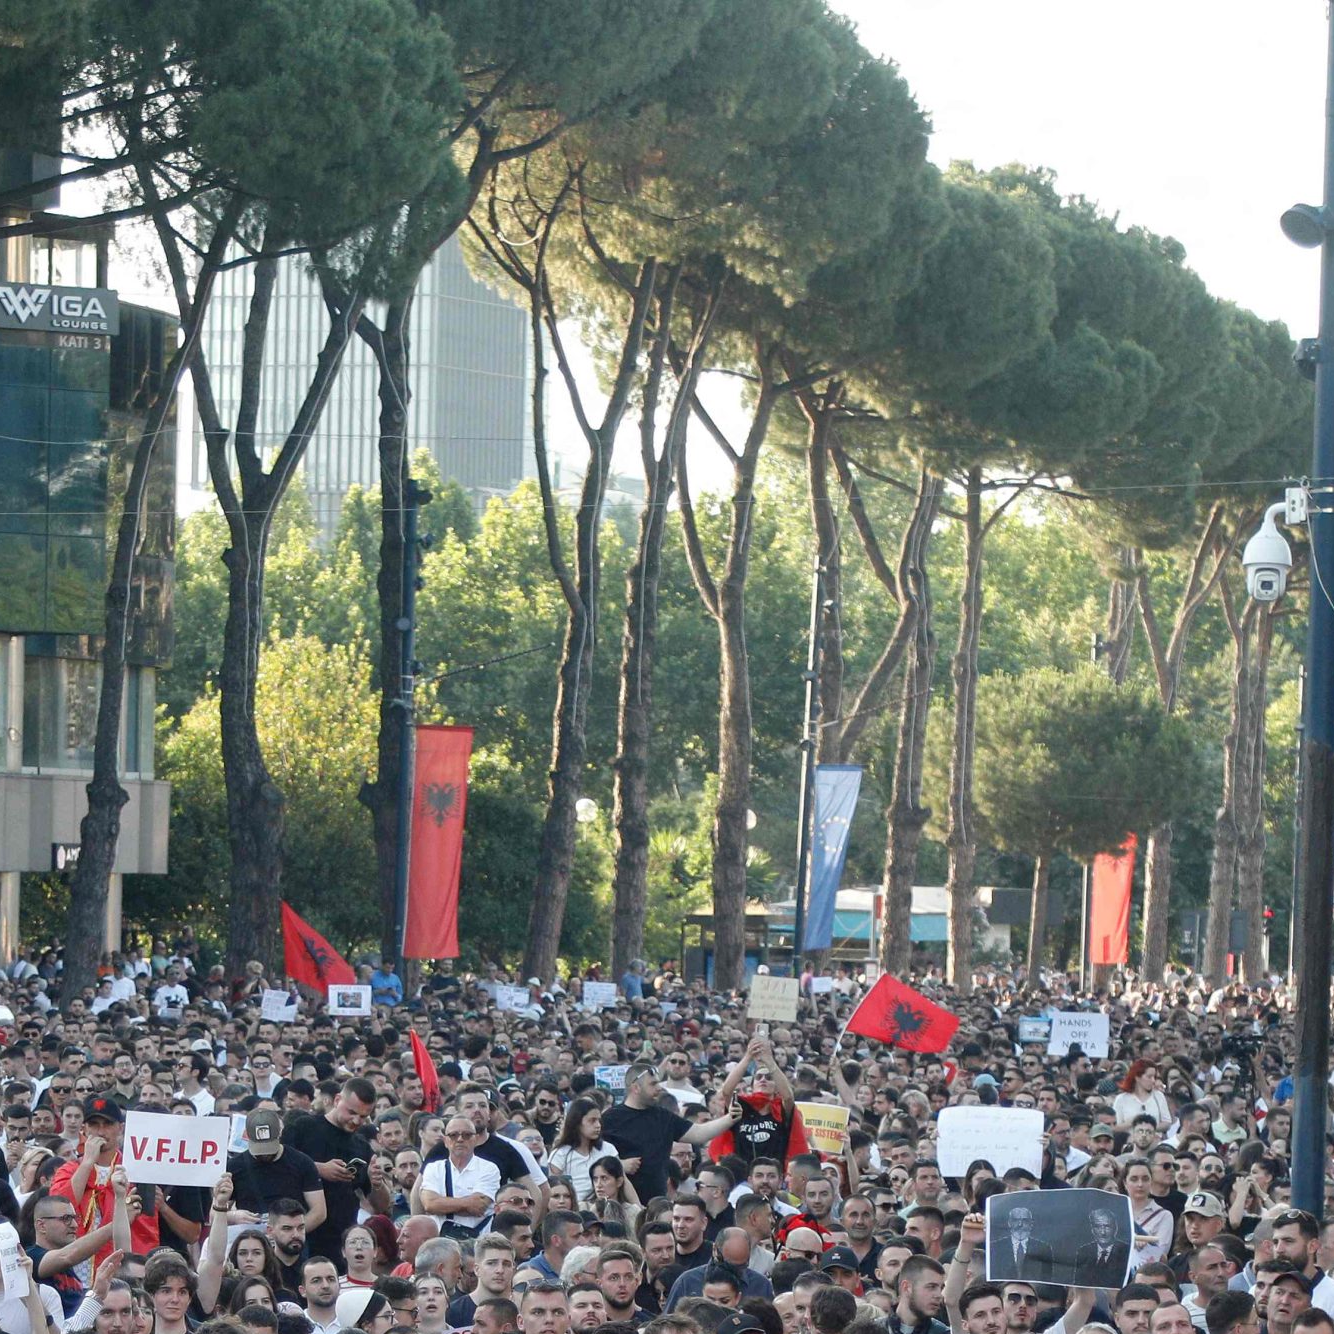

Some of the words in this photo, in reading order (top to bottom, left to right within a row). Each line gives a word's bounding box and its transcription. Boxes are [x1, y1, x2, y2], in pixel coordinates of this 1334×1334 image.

[52, 319, 108, 330] LOUNGE
[58, 335, 88, 349] KATI
[93, 338, 102, 350] 3
[1059, 1019, 1092, 1027] HANDS
[1070, 1031, 1089, 1039] OFF
[1062, 1041, 1097, 1049] NRTA
[130, 1136, 221, 1165] V.F.L.P.
